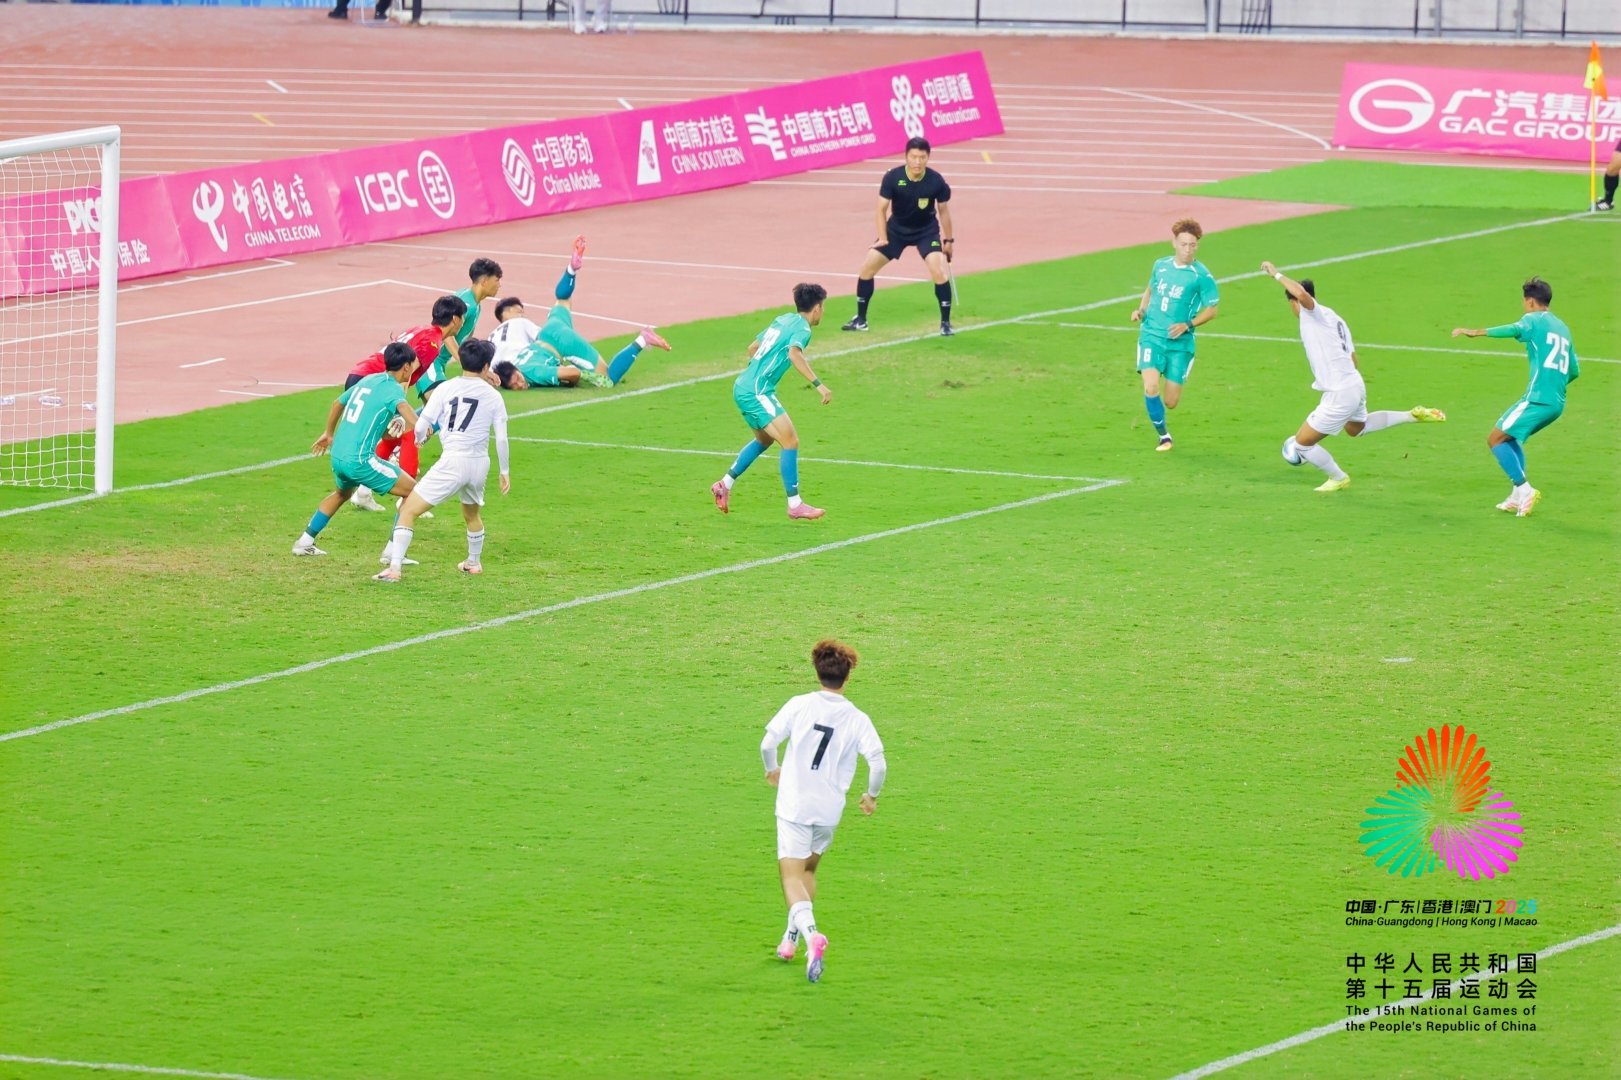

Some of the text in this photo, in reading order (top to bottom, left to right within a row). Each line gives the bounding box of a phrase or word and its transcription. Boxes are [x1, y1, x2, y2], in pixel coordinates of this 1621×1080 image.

[922, 73, 975, 104] 中国联通
[662, 114, 739, 152] 中国南方航空
[781, 102, 873, 145] 中国南方电网
[1439, 116, 1508, 136] GAC
[532, 132, 594, 171] 中国移动
[672, 146, 746, 175] CHINA SOUTHERN
[790, 133, 876, 157] CHINA SOUTHERN POWER GRID
[354, 168, 419, 215] ICBC
[542, 168, 603, 196] China Mobile
[231, 173, 314, 231] 中国电信
[244, 224, 321, 248] CHINA TELECOM
[50, 238, 151, 279] 中国人保险
[1160, 296, 1169, 312] 6
[1143, 348, 1152, 362] 6
[1336, 320, 1349, 353] 9
[1543, 332, 1569, 375] 25
[342, 386, 372, 424] 15
[448, 396, 479, 433] 17
[811, 724, 834, 770] 7
